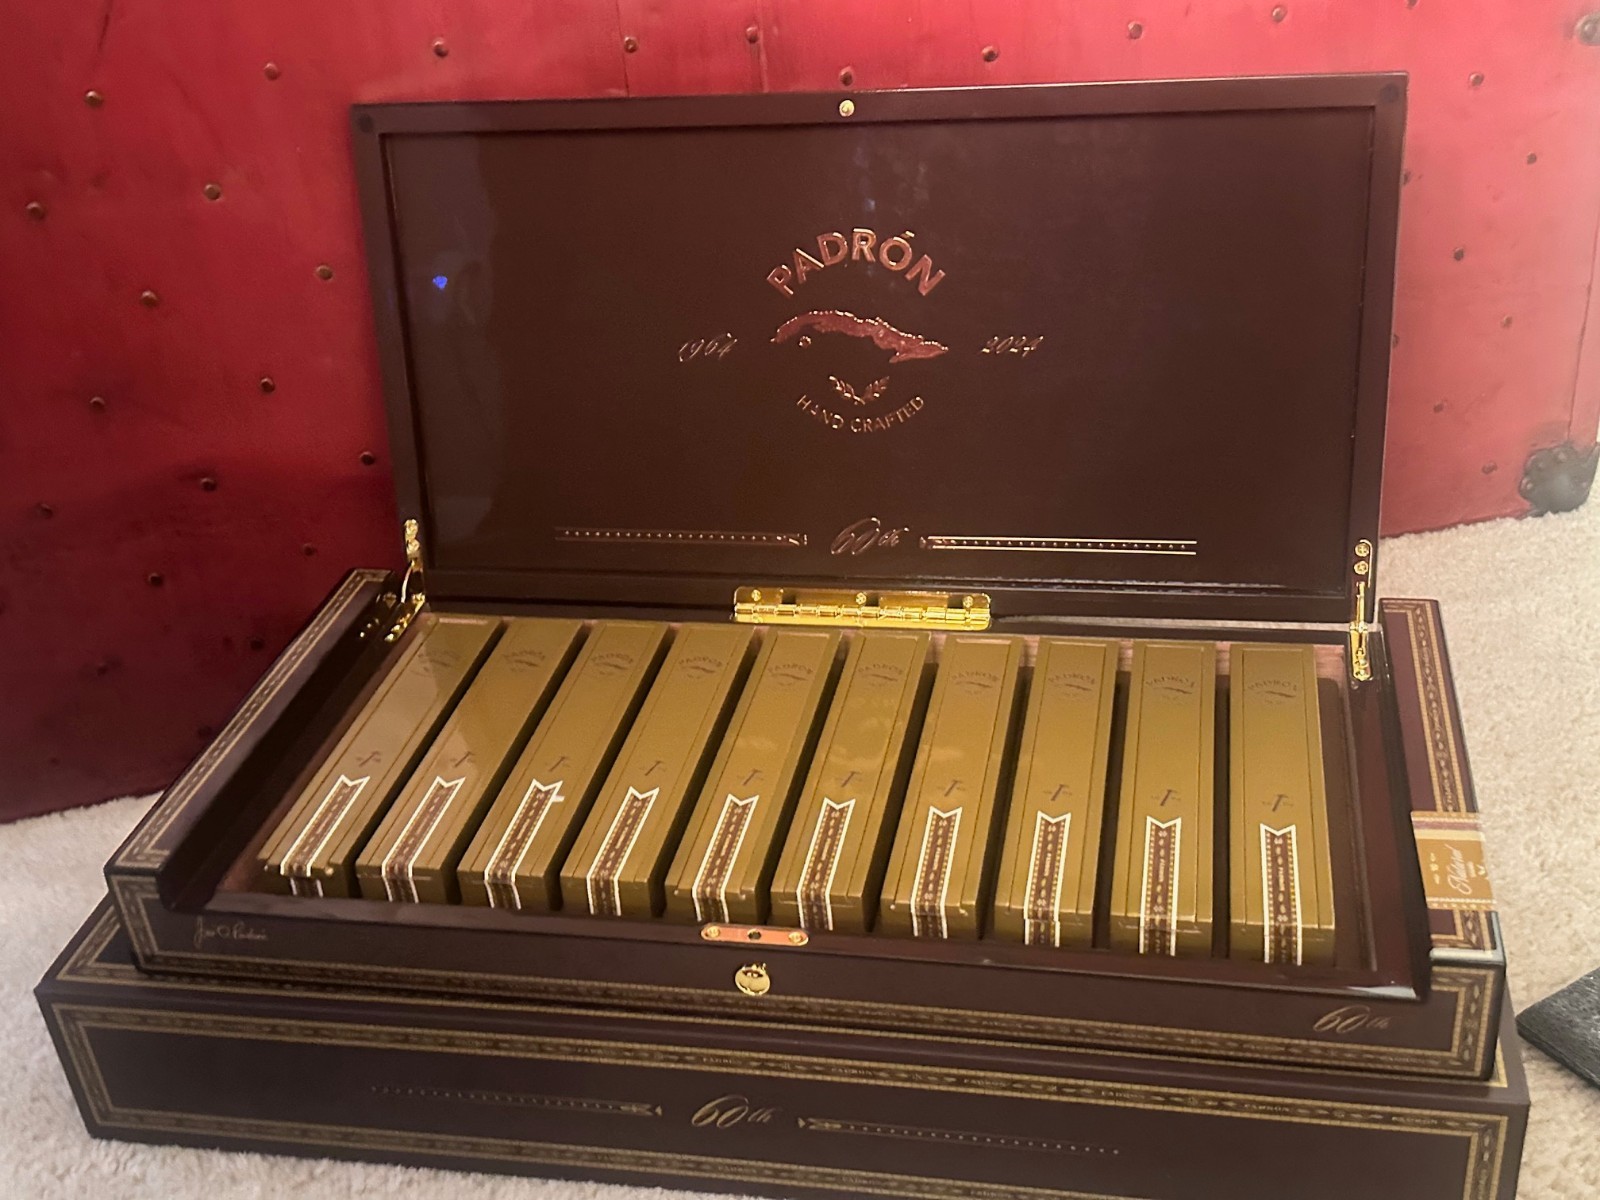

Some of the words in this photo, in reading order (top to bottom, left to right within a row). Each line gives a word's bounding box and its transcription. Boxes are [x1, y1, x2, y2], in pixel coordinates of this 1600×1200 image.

[766, 226, 946, 298] PADRÓN
[678, 332, 738, 362] 1964
[977, 335, 1044, 358] 2024
[796, 394, 845, 429] HAND
[850, 396, 924, 432] CRAFTED
[830, 517, 910, 556] 60th
[1312, 1003, 1393, 1035] 60th
[691, 1093, 777, 1130] 60th
